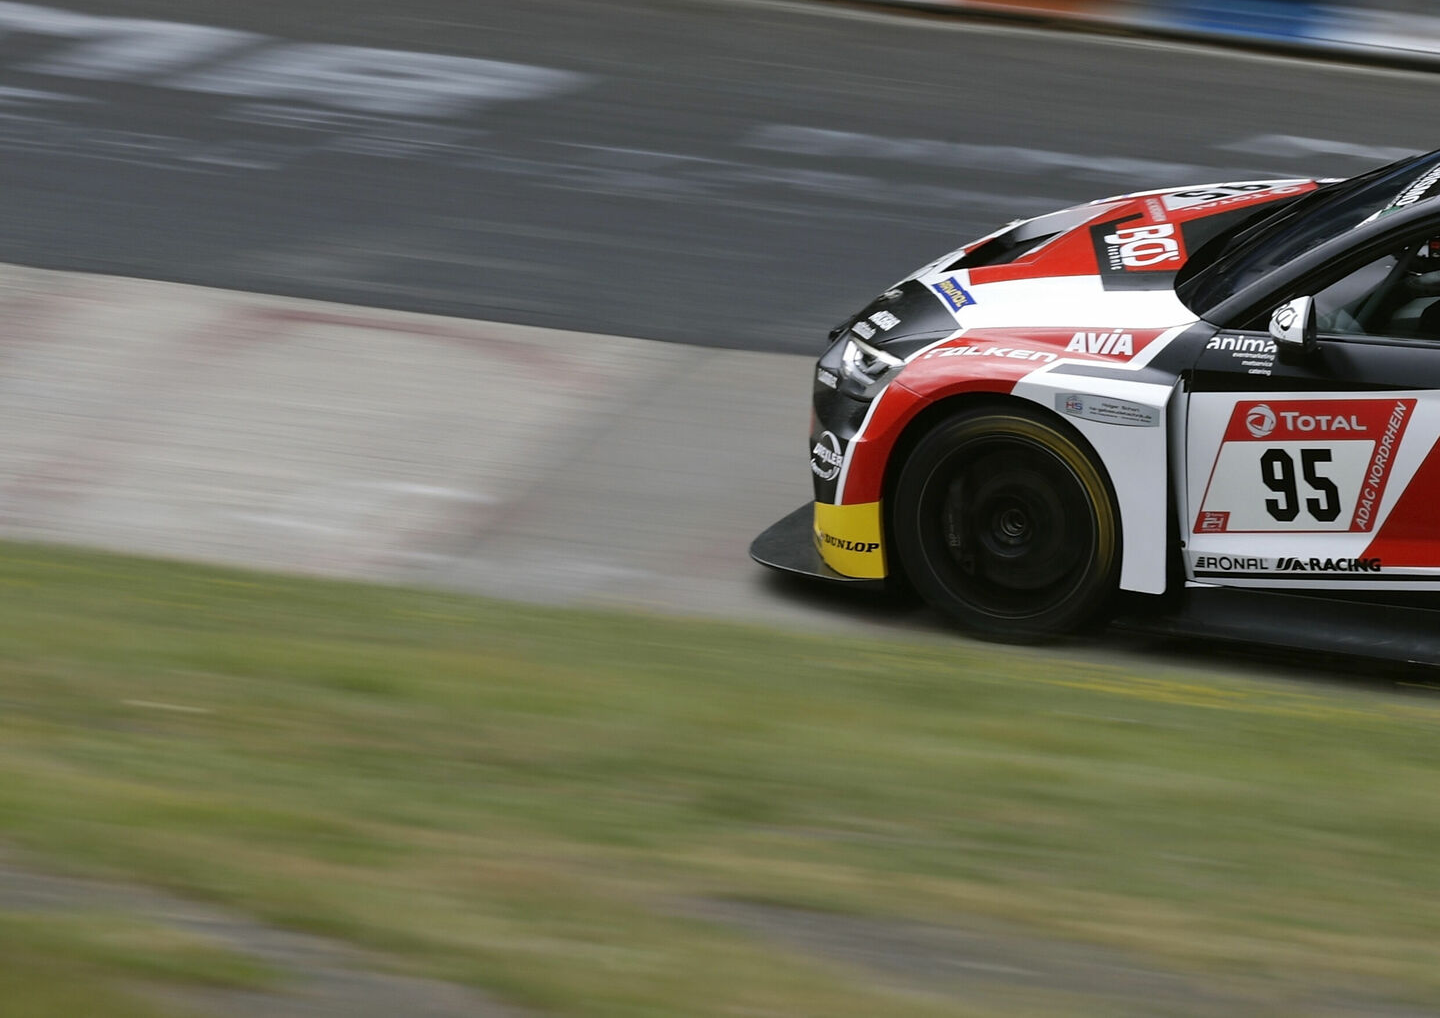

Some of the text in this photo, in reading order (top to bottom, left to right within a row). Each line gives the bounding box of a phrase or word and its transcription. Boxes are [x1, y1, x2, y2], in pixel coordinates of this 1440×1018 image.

[1206, 335, 1278, 353] anima
[1280, 411, 1367, 431] TOTAL
[1354, 400, 1408, 531] ADAC NORDRHEIN
[1260, 448, 1342, 522] 95
[825, 534, 879, 553] DUNLOP
